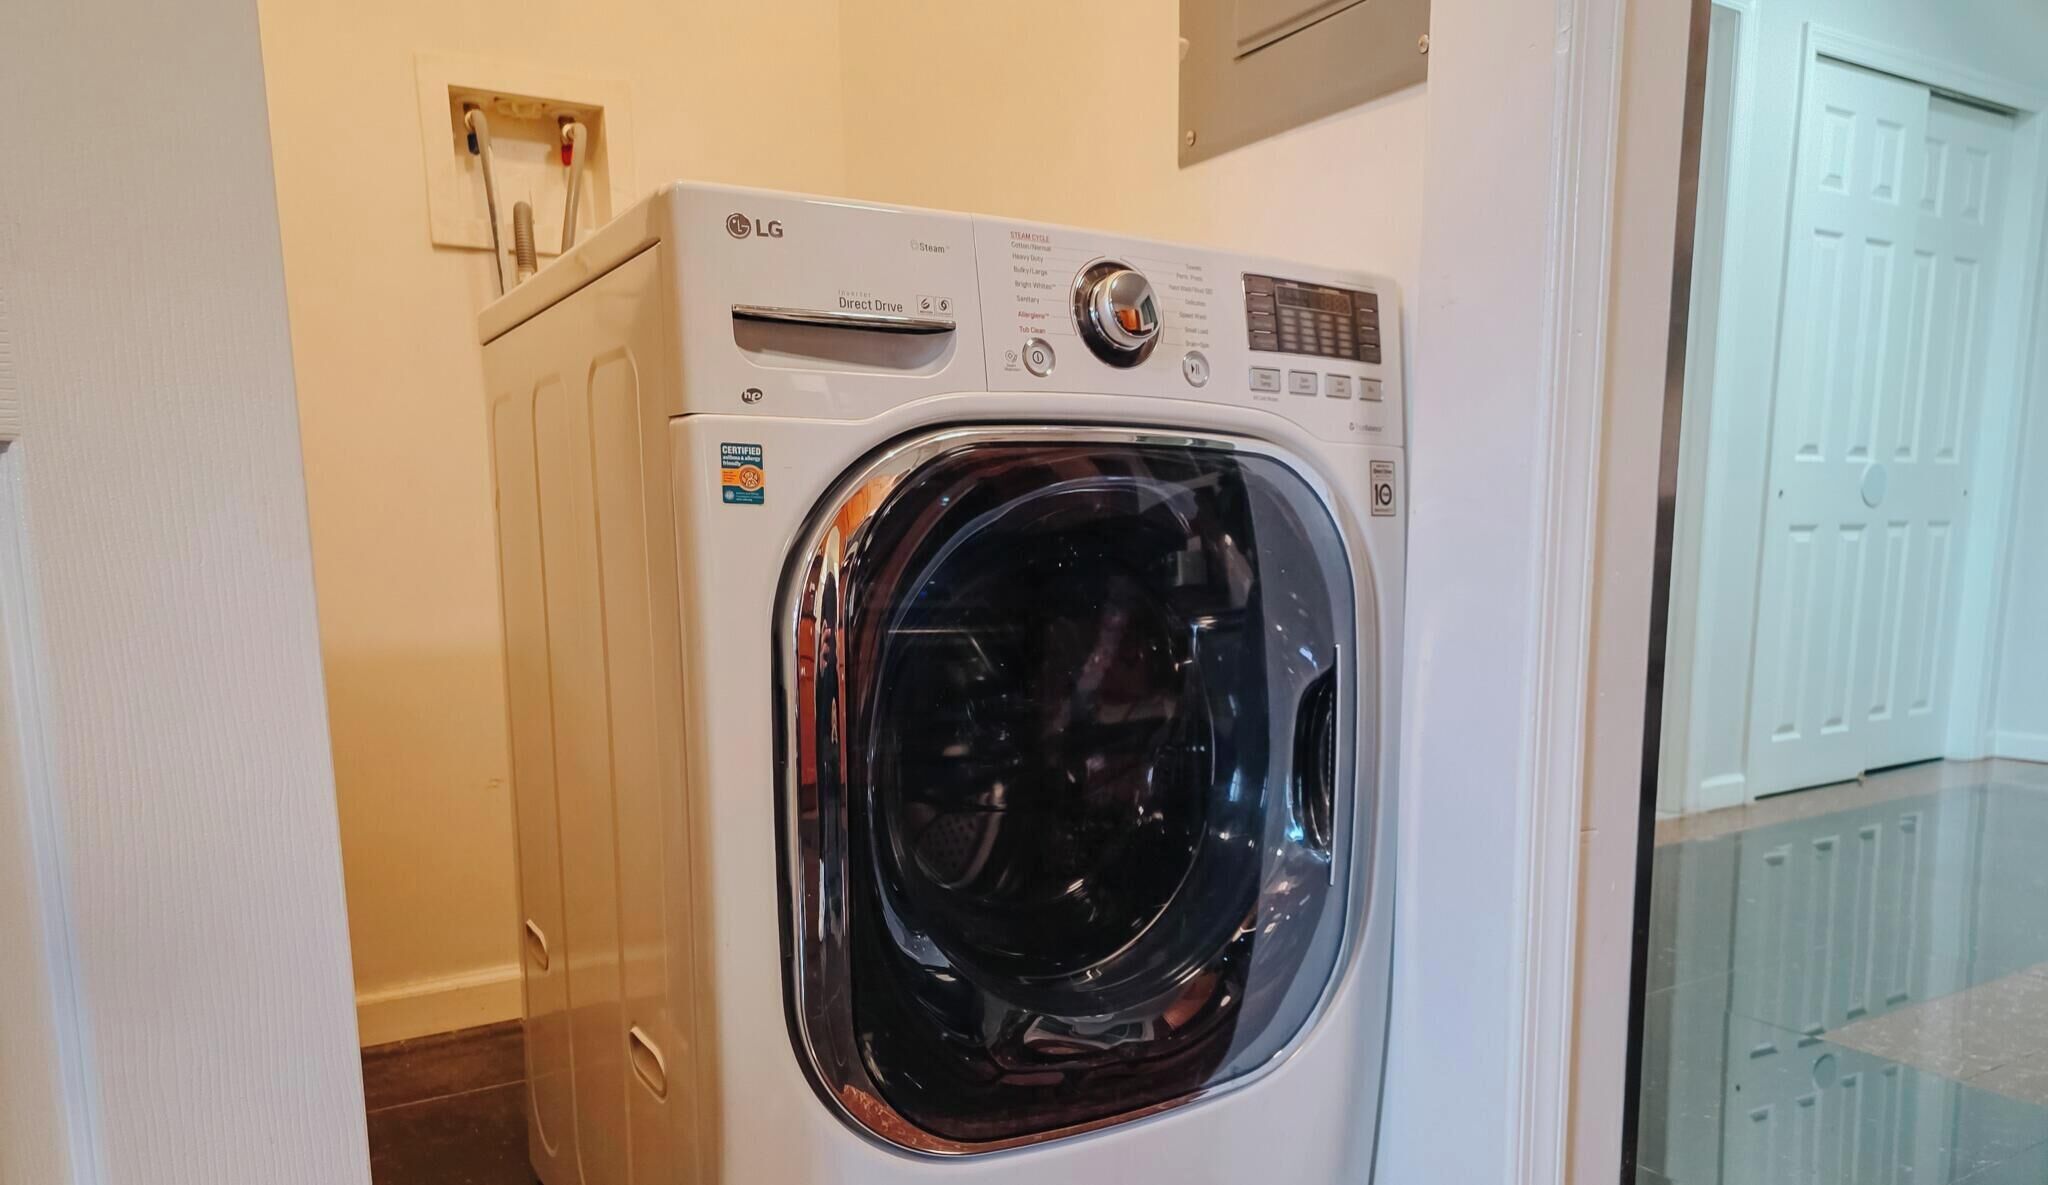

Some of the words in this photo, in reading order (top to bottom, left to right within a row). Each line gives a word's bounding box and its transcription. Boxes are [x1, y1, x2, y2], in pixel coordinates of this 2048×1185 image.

[755, 219, 783, 238] LG
[1010, 231, 1031, 241] STEAM
[919, 242, 945, 253] Steam
[1012, 253, 1030, 262] Heavy
[1030, 255, 1044, 264] Duty
[1013, 266, 1048, 276] Bulky/Large
[1014, 280, 1031, 289] Bright
[838, 289, 871, 298] Inverter
[839, 297, 873, 311] Direct
[875, 300, 903, 313] Drive
[1016, 295, 1040, 305] Sanitary
[1019, 326, 1030, 334] Tub
[1030, 327, 1046, 335] Clean
[722, 445, 761, 456] CERTIFIED
[1374, 483, 1393, 506] 10
